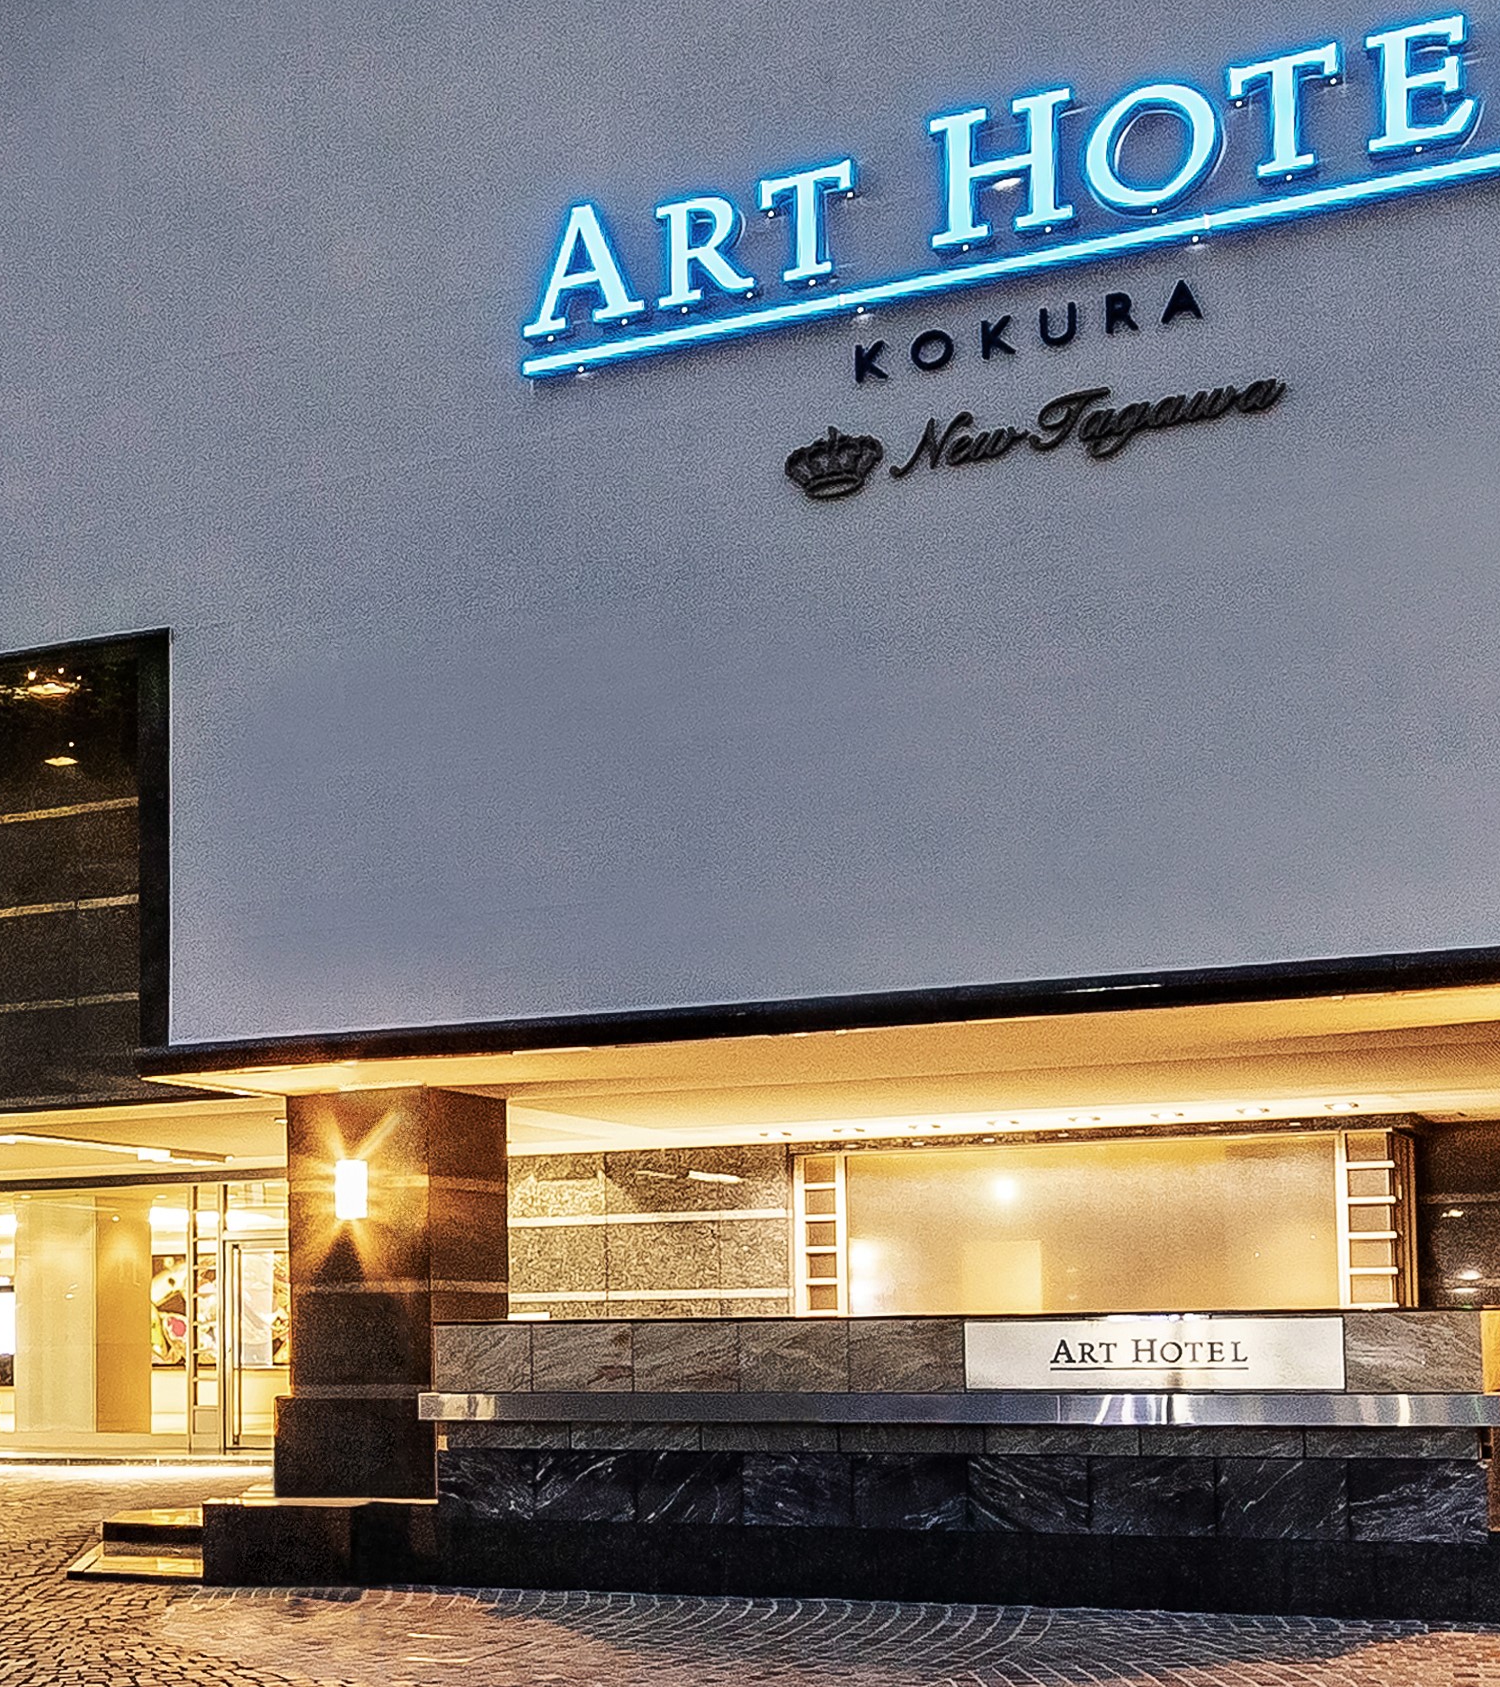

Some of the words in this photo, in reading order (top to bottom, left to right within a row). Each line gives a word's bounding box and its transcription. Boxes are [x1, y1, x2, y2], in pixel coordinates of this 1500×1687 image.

[522, 155, 856, 342] ART
[852, 278, 1208, 384] KOKURA
[888, 411, 1028, 479] New
[1029, 378, 1286, 461] Tagawa
[1049, 1338, 1118, 1365] ART
[1131, 1337, 1249, 1364] HOTEL
